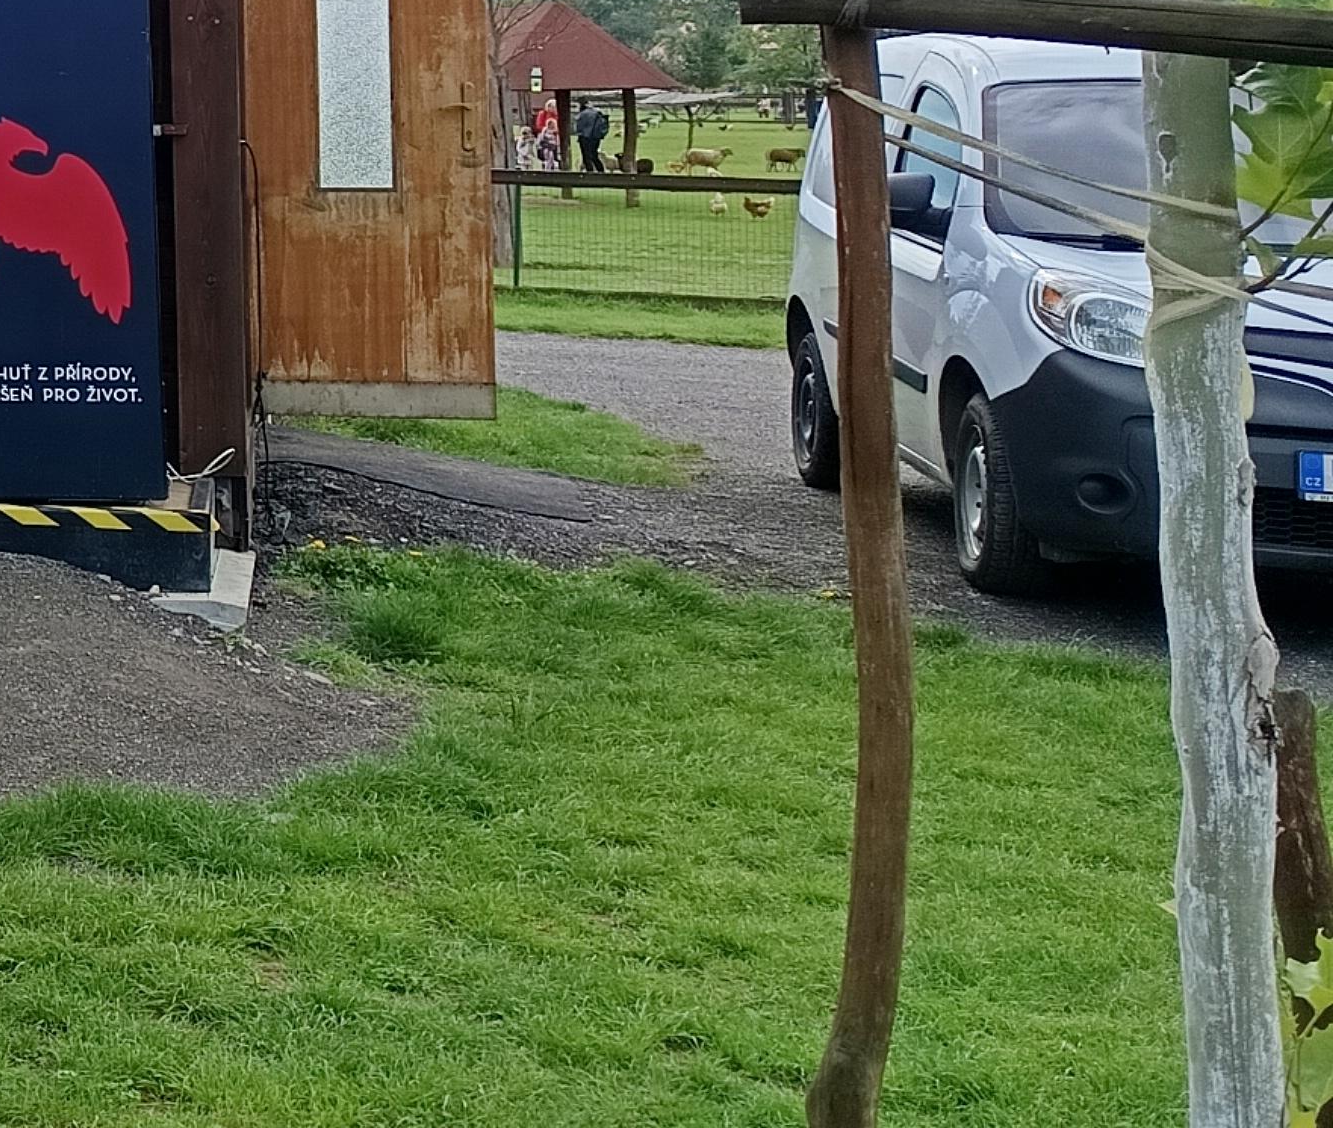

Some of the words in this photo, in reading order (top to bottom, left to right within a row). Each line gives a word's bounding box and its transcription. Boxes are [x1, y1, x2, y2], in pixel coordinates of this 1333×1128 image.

[37, 367, 49, 381] Z
[54, 362, 137, 384] PŘÍRODY,
[42, 387, 81, 402] PRO
[86, 385, 144, 403] ŽIVOT.
[1305, 477, 1322, 487] CZ
